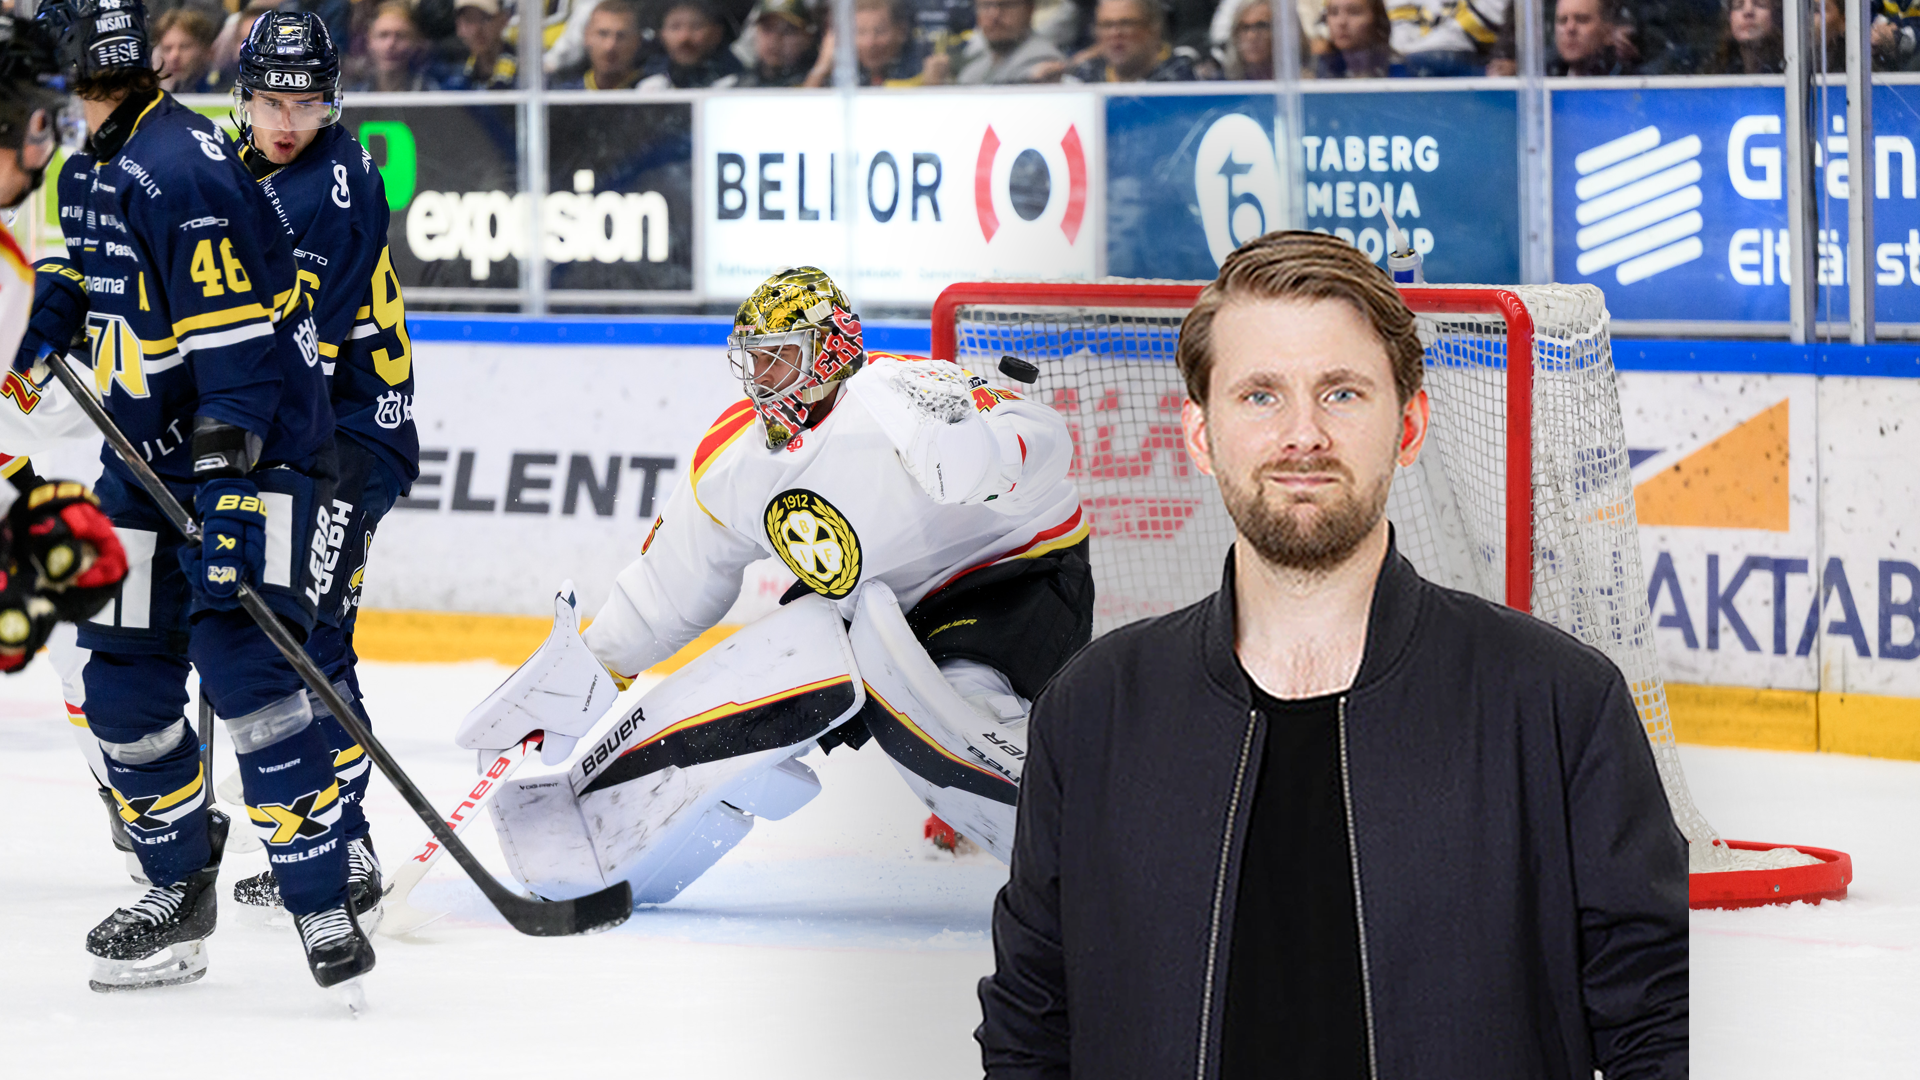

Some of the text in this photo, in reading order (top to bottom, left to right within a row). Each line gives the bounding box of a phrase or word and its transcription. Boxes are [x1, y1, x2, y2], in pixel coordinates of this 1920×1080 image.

[98, 41, 140, 65] HSE
[269, 72, 308, 88] EAB
[1301, 135, 1440, 172] TABERG
[1306, 181, 1421, 219] MEDIA
[1309, 226, 1435, 264] ROUP
[190, 237, 252, 297] 46
[390, 449, 677, 518] ELENT
[782, 494, 810, 510] 1912
[798, 519, 810, 534] B
[823, 547, 832, 563] F
[271, 838, 339, 865] AXELENT
